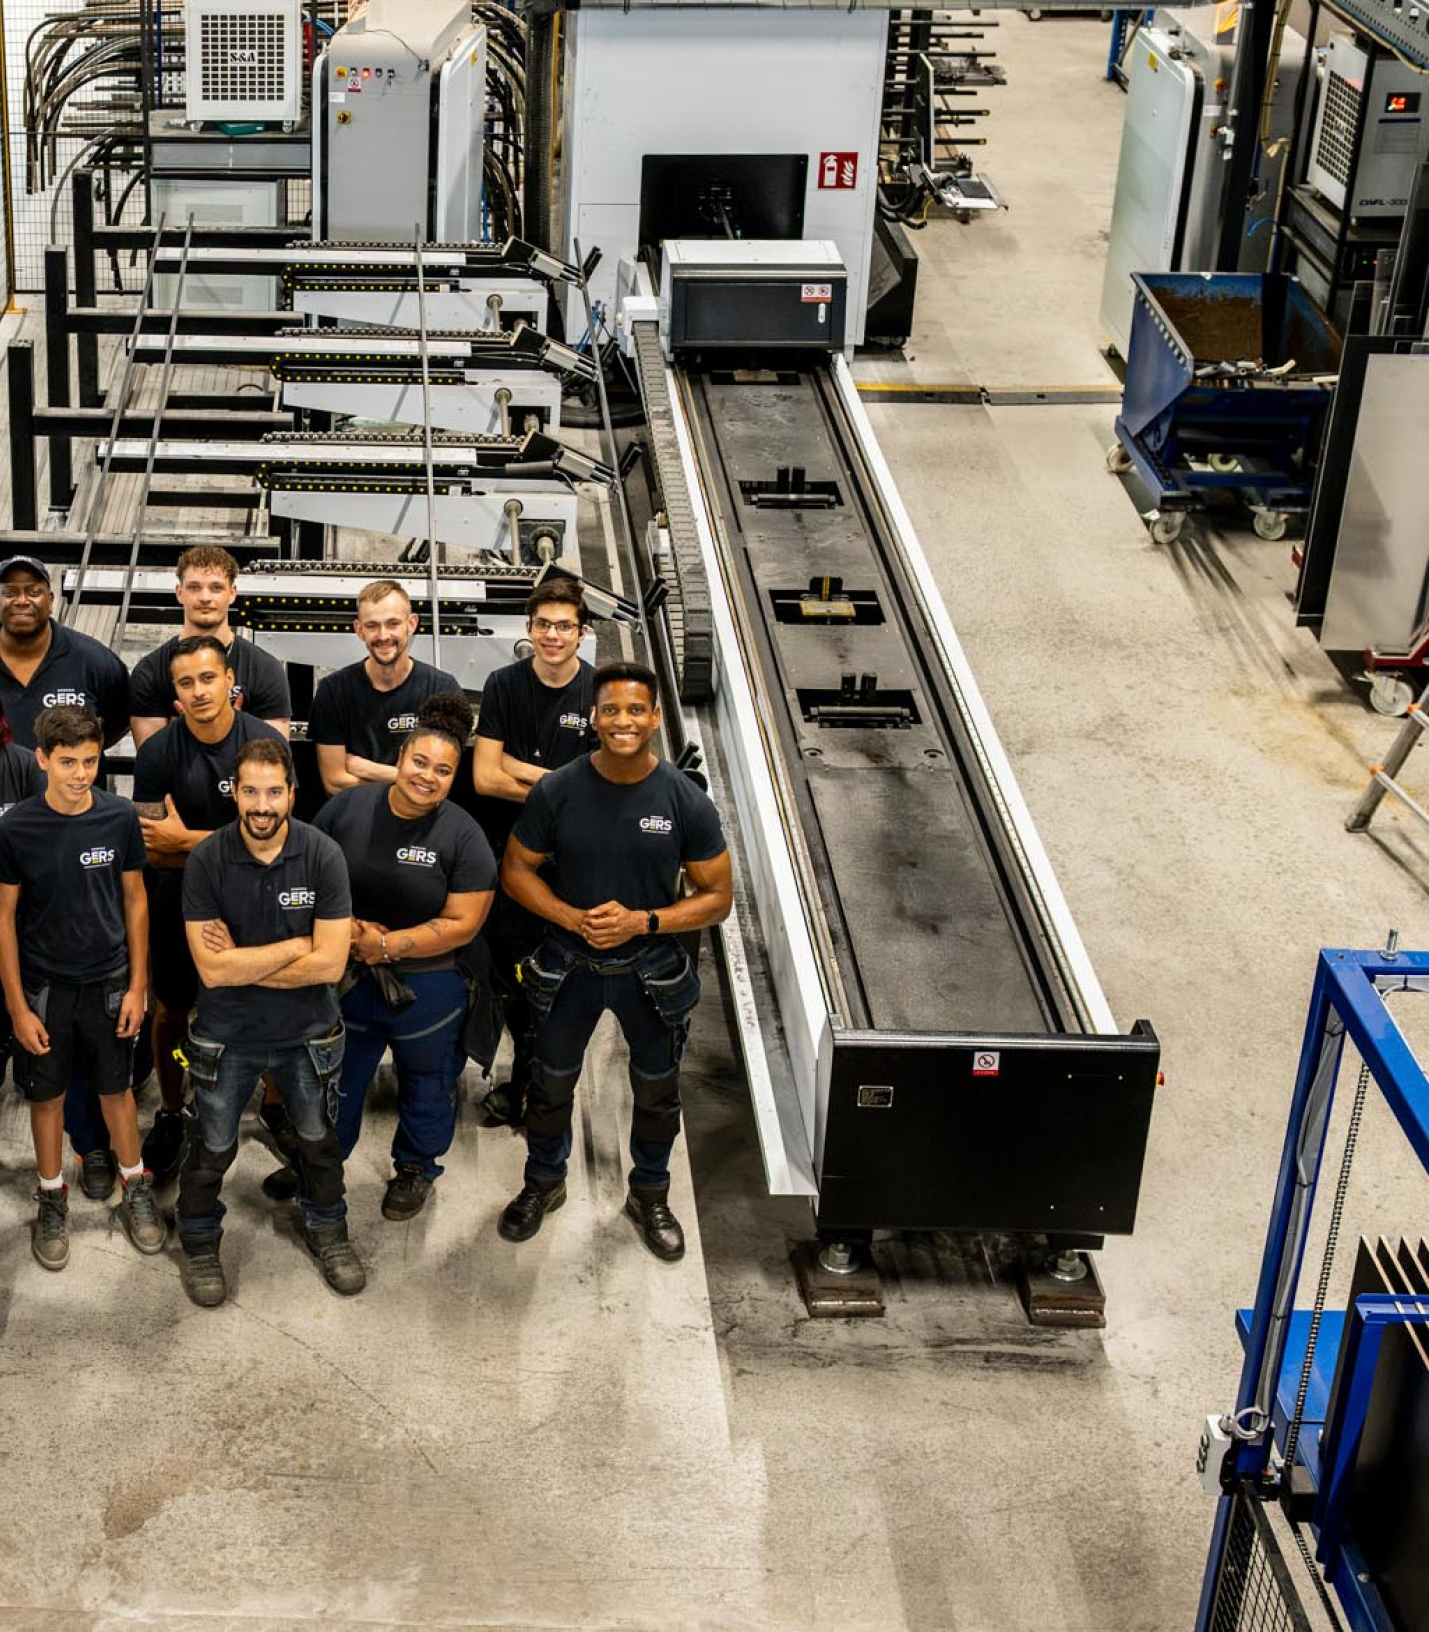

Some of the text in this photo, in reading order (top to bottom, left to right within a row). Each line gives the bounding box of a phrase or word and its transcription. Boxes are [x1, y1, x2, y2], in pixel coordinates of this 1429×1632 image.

[230, 52, 256, 62] S&A
[43, 693, 86, 708] GERS
[560, 714, 588, 728] GERS
[639, 818, 672, 832] GERS
[80, 849, 116, 865] GERS
[397, 847, 436, 863] GERS
[278, 890, 316, 906] GERS
